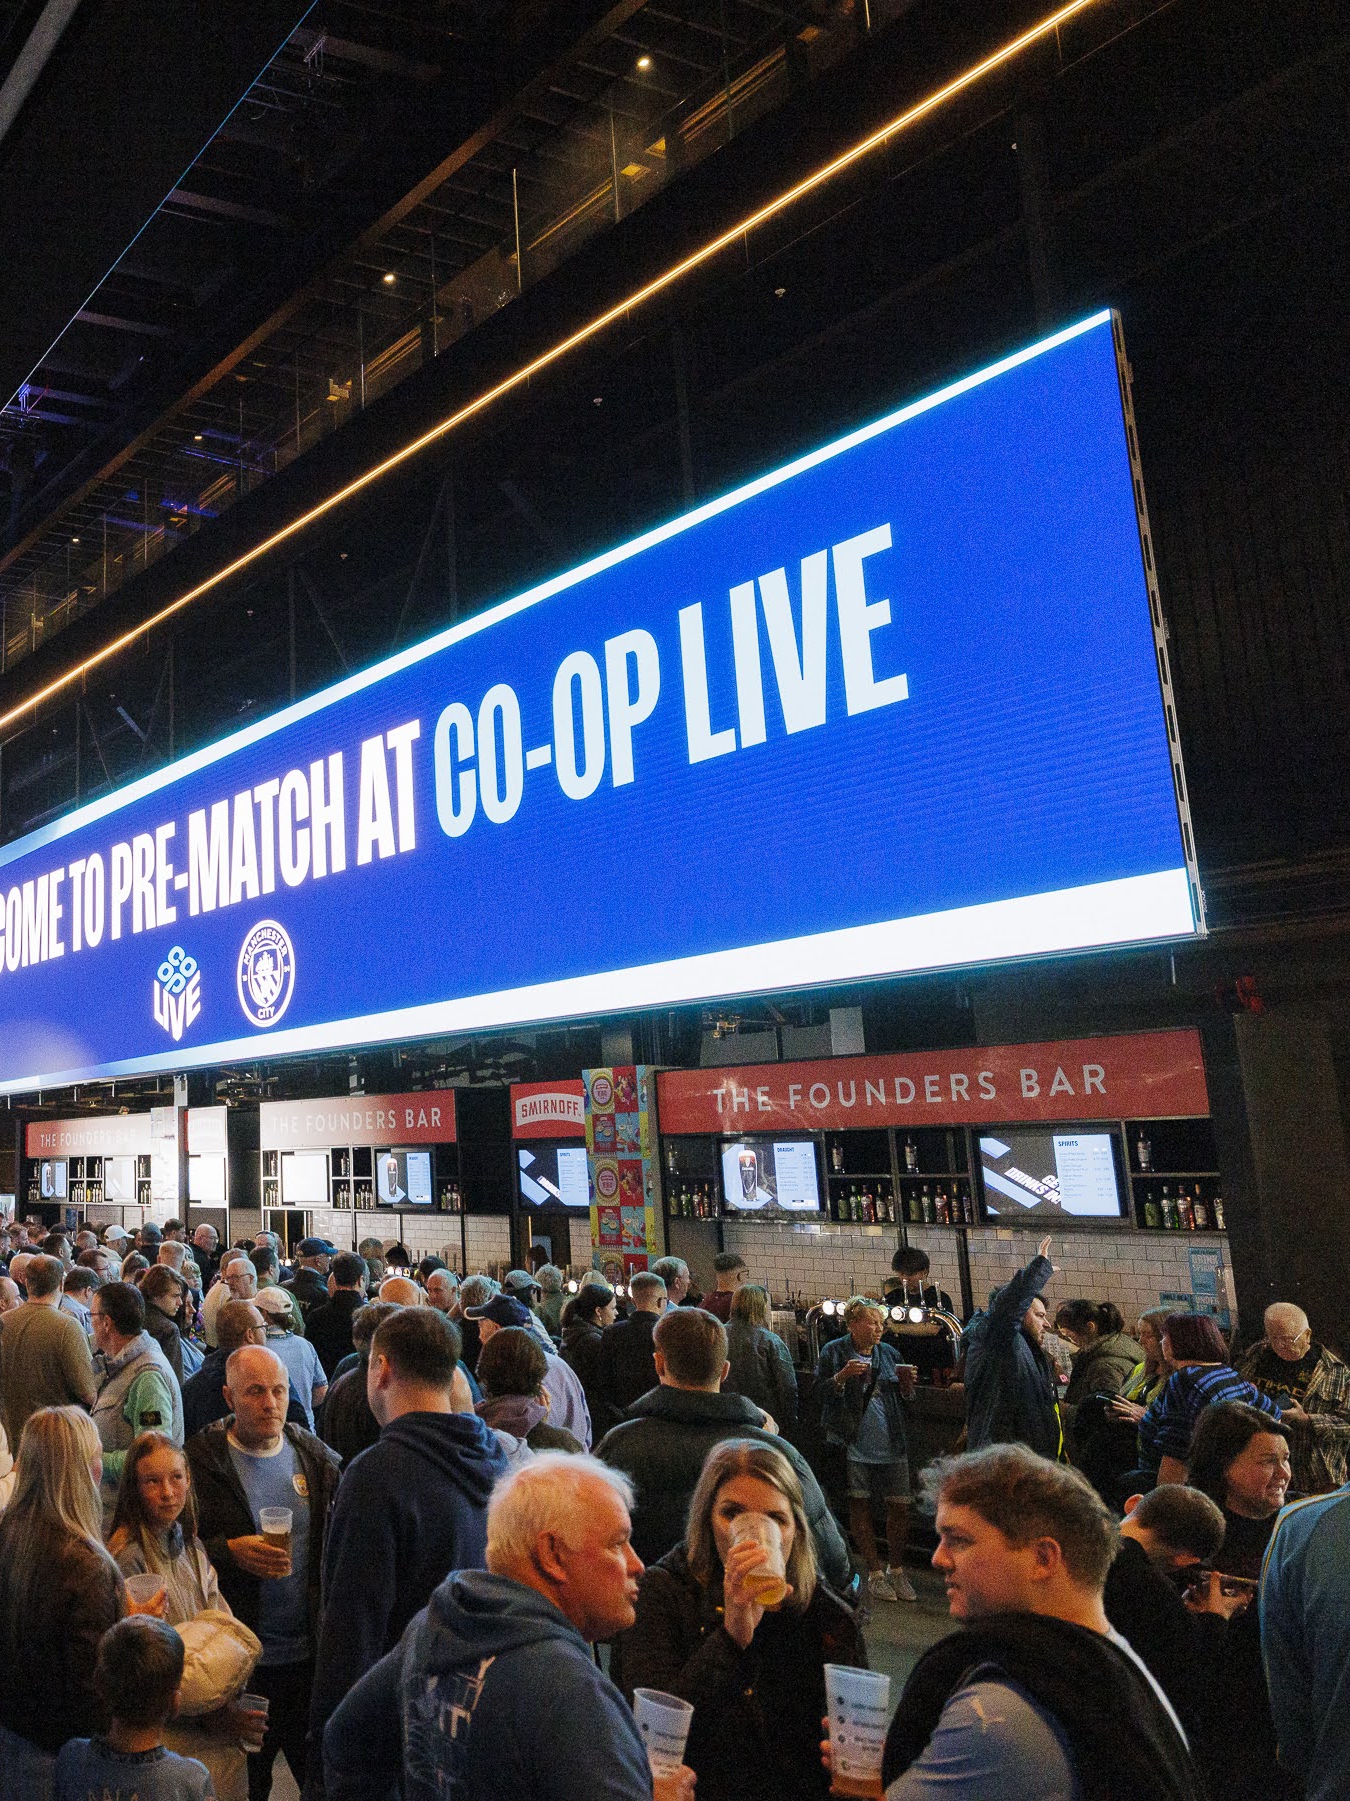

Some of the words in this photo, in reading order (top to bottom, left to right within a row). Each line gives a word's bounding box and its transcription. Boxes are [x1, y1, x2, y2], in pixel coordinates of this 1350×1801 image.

[69, 853, 104, 951] TO
[111, 752, 346, 940] PRE-MATCH
[357, 719, 421, 866] AT
[434, 629, 660, 838] CO-OP
[679, 522, 909, 764] LIVE
[243, 929, 288, 965] MANCHESTER
[154, 970, 200, 1042] LIVE
[257, 1006, 275, 1019] CITY
[713, 1086, 771, 1113] THE
[789, 1071, 997, 1110] FOUNDERS
[1019, 1064, 1107, 1098] BAR
[272, 1115, 299, 1134] THE
[306, 1109, 397, 1133] FOUNDERS
[406, 1107, 441, 1129] BAR
[521, 1099, 579, 1119] SMIRNOFF
[40, 1133, 57, 1148] THE
[60, 1130, 111, 1146] FOUNDERS
[1004, 1167, 1047, 1195] DRINKS
